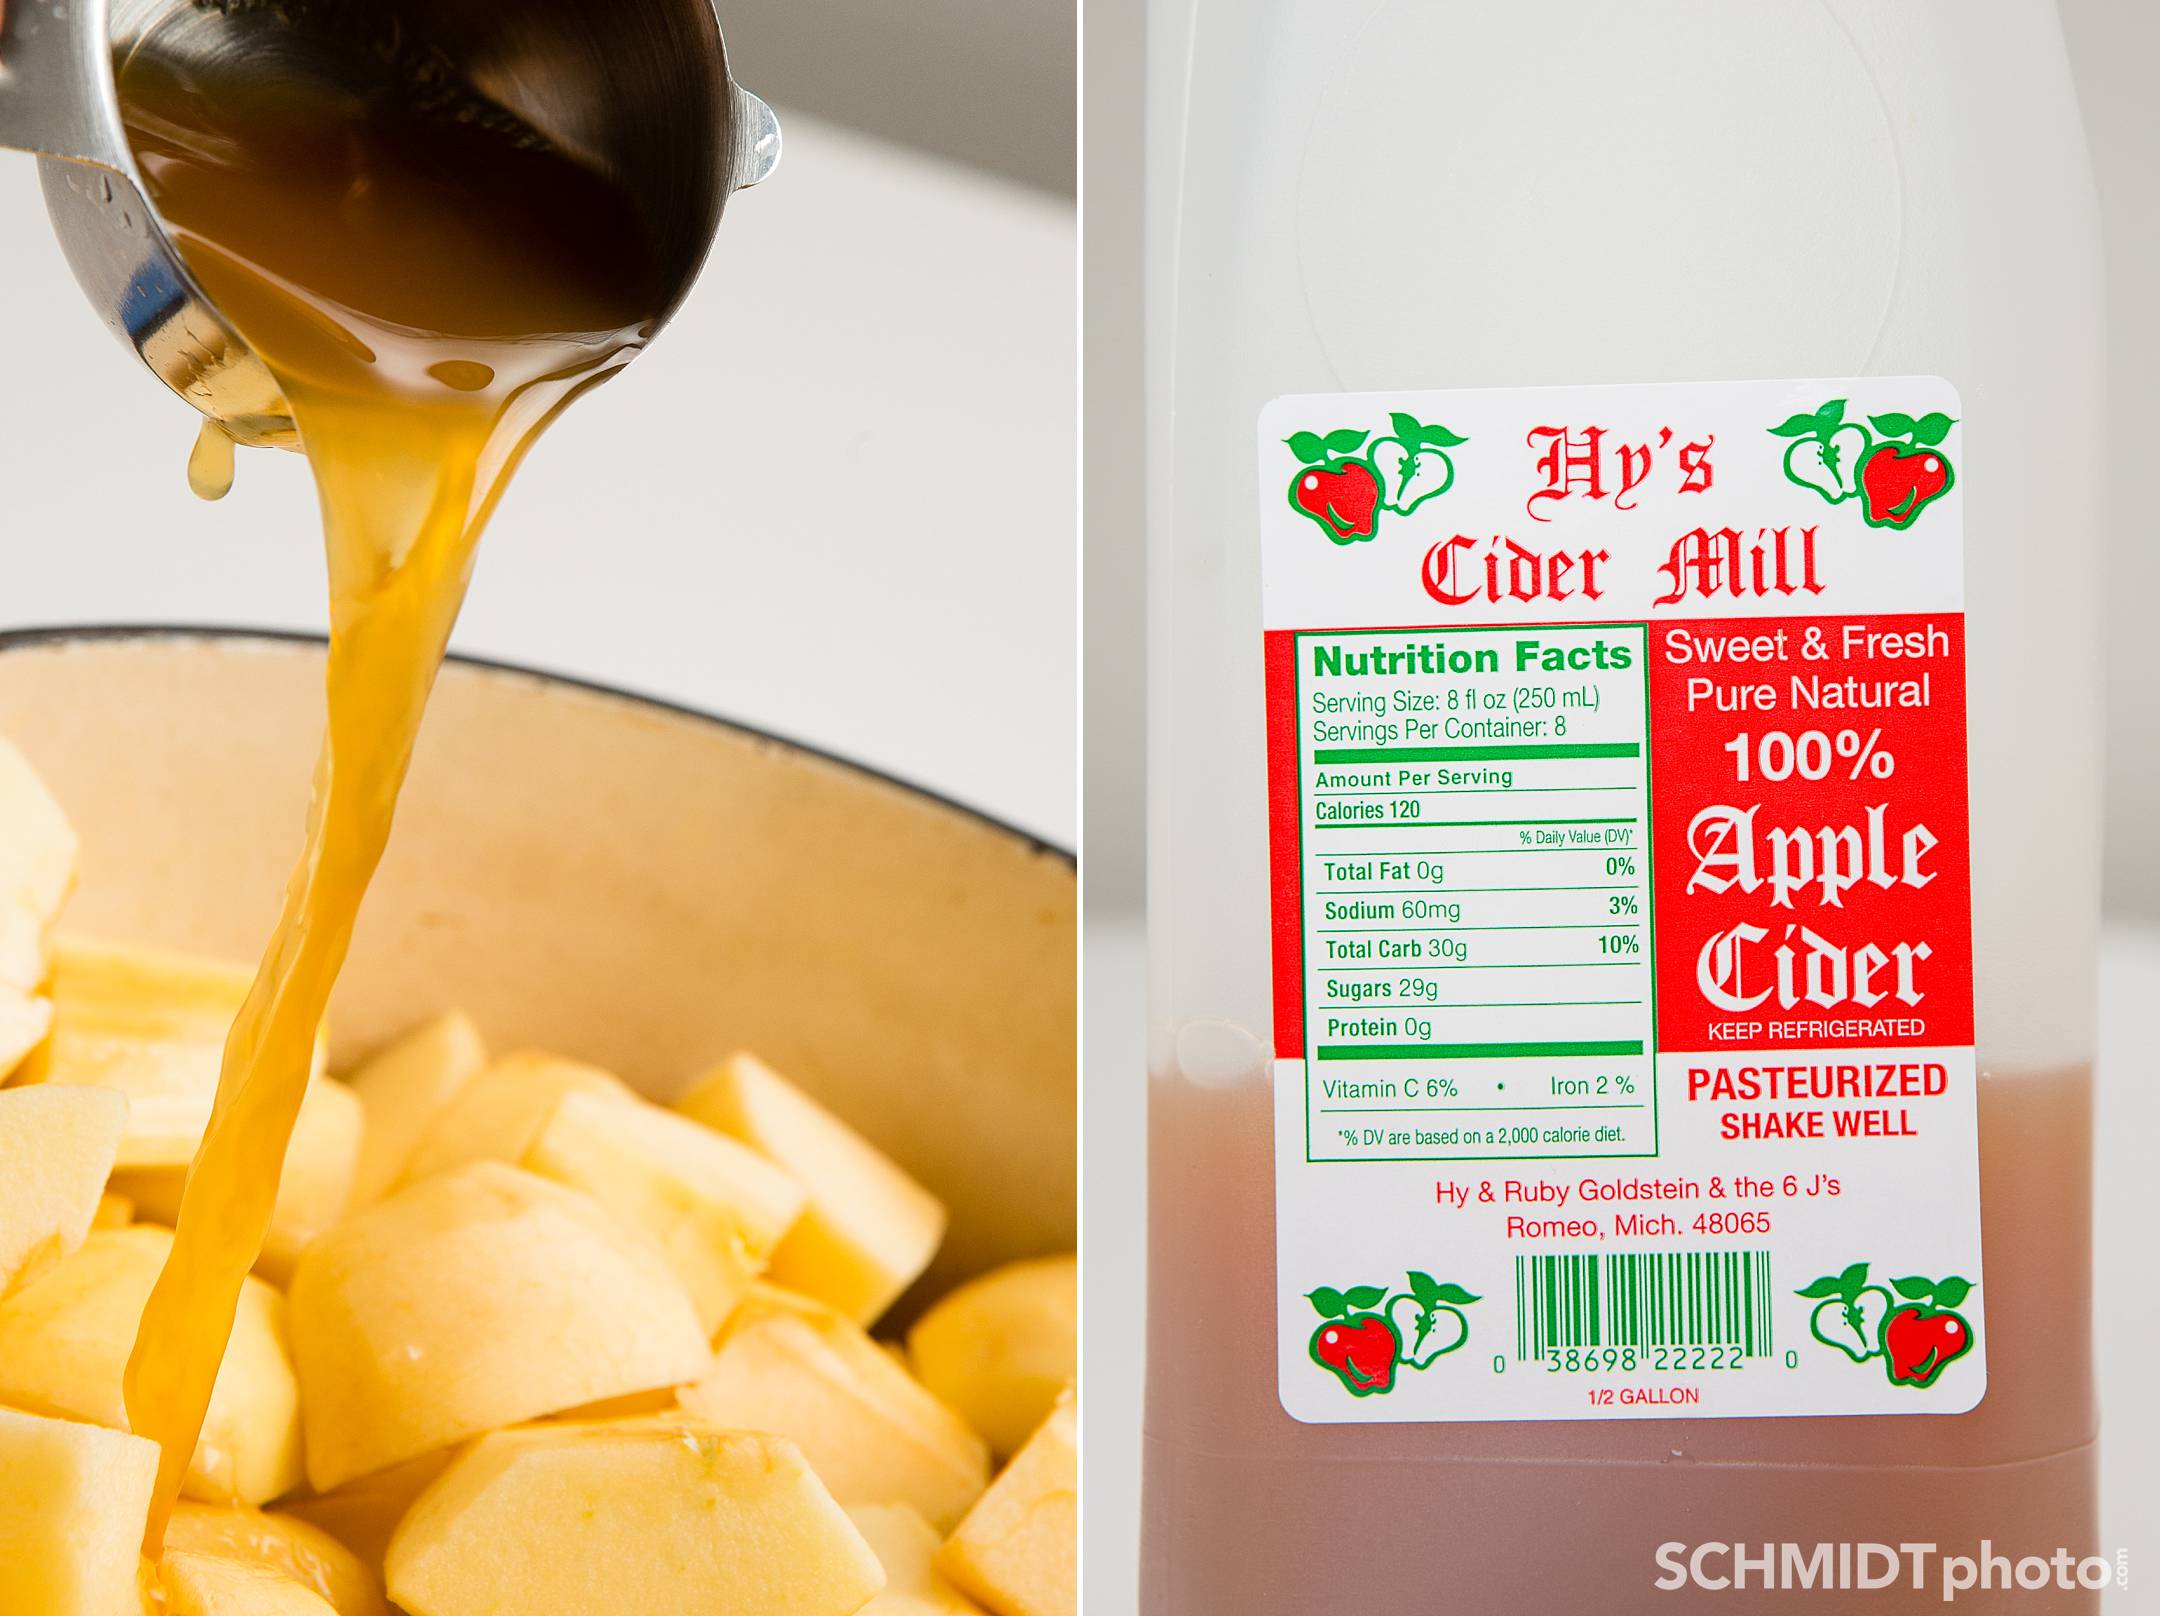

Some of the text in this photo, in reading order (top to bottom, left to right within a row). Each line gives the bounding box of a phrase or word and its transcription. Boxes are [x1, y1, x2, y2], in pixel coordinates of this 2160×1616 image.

[1526, 425, 1715, 522] Hy's
[1421, 525, 1826, 608] Cider Mill
[1666, 624, 1948, 663] Sweet & Fresh
[1314, 640, 1632, 677] Nutrition Facts
[1314, 685, 1600, 717] Serving Size: 8 fl oz (250 mL)
[1688, 673, 1929, 711] Pure Natural
[1314, 717, 1566, 745] Servings Per Container: 8
[1725, 728, 1894, 781] 100%
[1316, 769, 1513, 788] Amount Per Serving
[1316, 800, 1420, 820] Calories 120
[1536, 829, 1565, 848] Daily
[1569, 829, 1601, 843] Value
[1606, 856, 1635, 876] 0%
[1687, 803, 1938, 909] Apple
[1325, 862, 1444, 882] Total Fat 0g
[1326, 900, 1460, 923] Sodium 60mg
[1610, 896, 1638, 914] 3%
[1327, 938, 1467, 960] Total Carb 30g
[1598, 935, 1639, 954] 10%
[1697, 923, 1932, 1011] Cider
[1328, 978, 1438, 1001] Sugars 29g
[1328, 1018, 1431, 1039] Protein 0g
[1709, 1019, 1925, 1040] KEEP REFRIGERATED
[1323, 1078, 1458, 1099] Vitamin C 6%
[1552, 1077, 1588, 1094] Iron
[1597, 1076, 1608, 1093] 2
[1688, 1063, 1948, 1102] PASTEURIZED
[1363, 1129, 1384, 1146] DV
[1390, 1134, 1410, 1144] are
[1416, 1130, 1458, 1144] based
[1463, 1132, 1481, 1143] on
[1485, 1131, 1495, 1145] a
[1498, 1126, 1539, 1143] 2,000
[1543, 1128, 1590, 1141] calorie
[1595, 1126, 1627, 1143] diet.
[1720, 1109, 1918, 1141] SHAKE WELL
[1436, 1174, 1840, 1209] Hy & Ruby Goldstein & the 6 J's
[1507, 1211, 1771, 1240] Romeo, Mich. 48065
[1494, 1355, 1504, 1372] 0
[1786, 1351, 1798, 1367] 0
[1588, 1387, 1699, 1406] 1/2 GALLON
